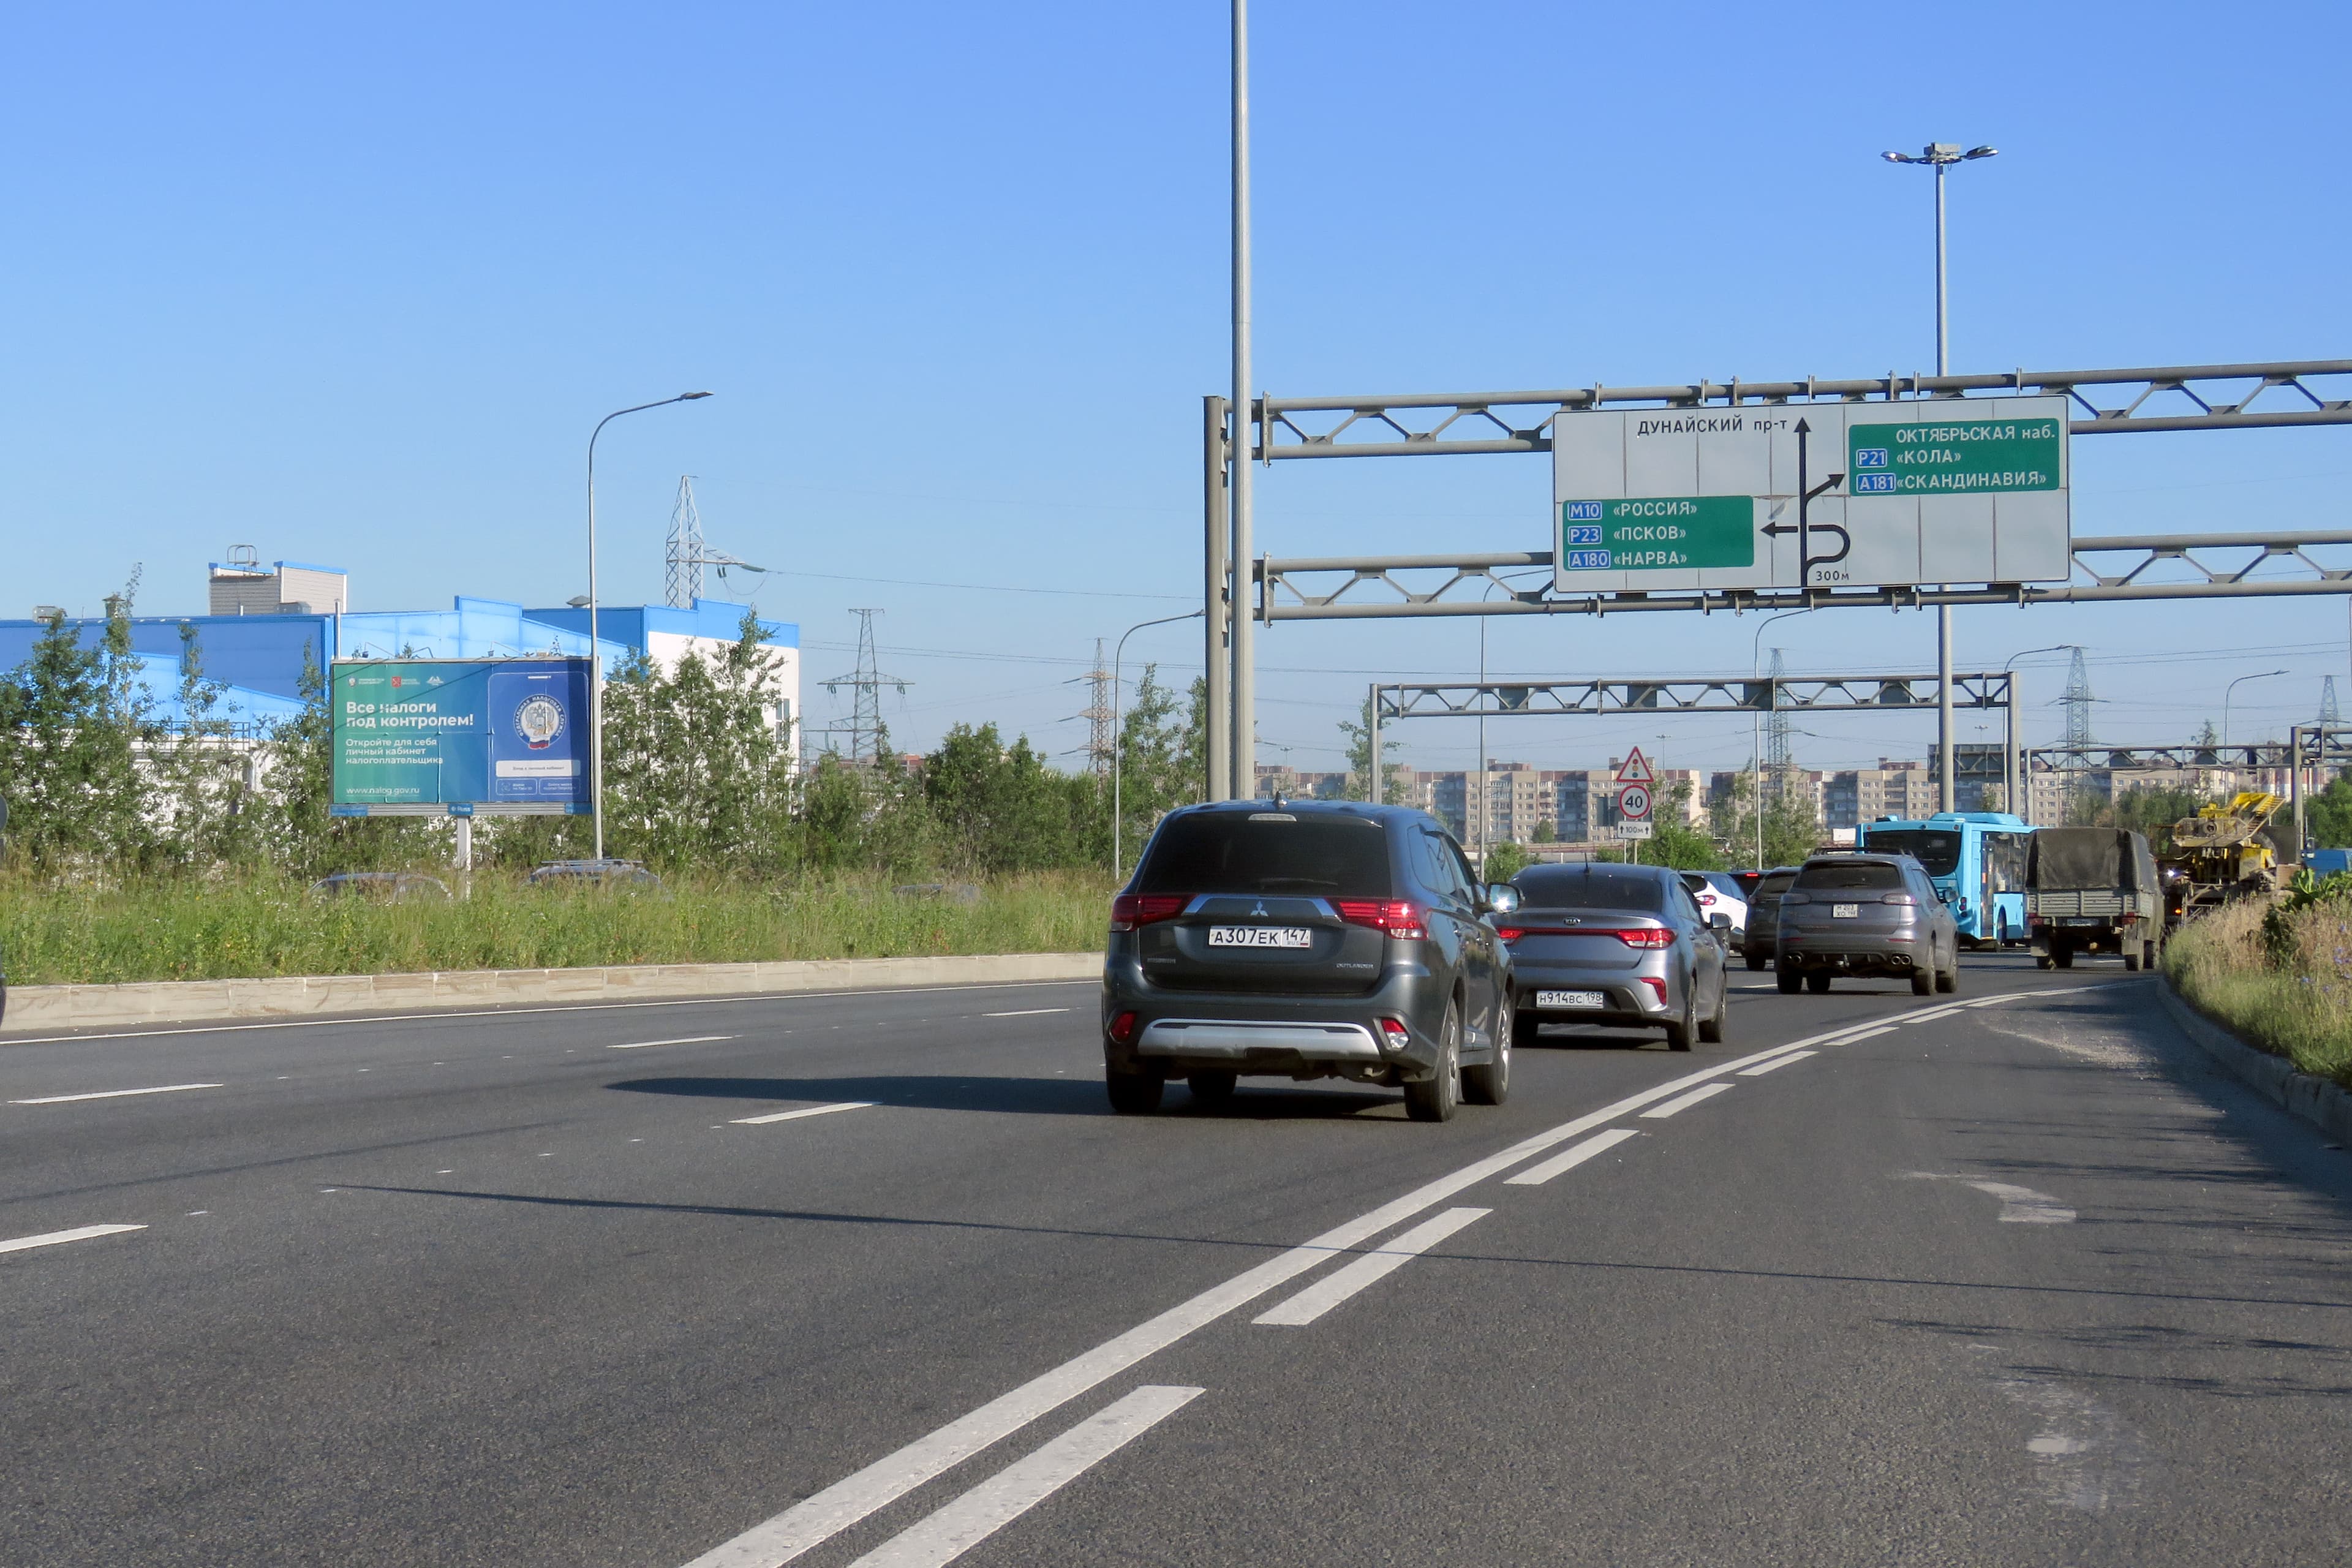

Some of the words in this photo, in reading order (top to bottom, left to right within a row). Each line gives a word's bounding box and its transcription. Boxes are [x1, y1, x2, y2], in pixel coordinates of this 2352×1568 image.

[1637, 413, 1743, 436] ДУНАЙСКИЙ
[1754, 420, 1788, 434] пр-т
[1896, 426, 2015, 443] ОКТЯБРЬСКАЯ
[2022, 424, 2056, 440] наб.
[1858, 450, 1886, 466] Р21
[1896, 449, 1961, 464] «КОЛА»
[1859, 476, 1894, 491] А181
[1897, 471, 2046, 489] «СКАНДИНАВИЯ»
[1570, 504, 1600, 518] М10
[1613, 501, 1697, 516] «РОССИЯ»
[1570, 528, 1599, 542] Р23
[1613, 526, 1686, 540] «ПСКОВ»
[1571, 552, 1608, 567] А180
[1613, 551, 1687, 565] «НАРВА»
[1815, 570, 1850, 581] 300м
[346, 701, 375, 714] Все
[379, 703, 437, 714] налоги
[346, 717, 377, 729] под
[380, 714, 474, 729] контролем!
[345, 738, 392, 747] Откройте
[414, 737, 438, 746] себя
[345, 747, 384, 756] личный
[385, 747, 426, 755] кабинет
[345, 756, 443, 766] налогоплательщика
[346, 786, 420, 796] www.nalog.gov.ru
[1625, 795, 1643, 808] 40
[1214, 927, 1279, 944] А307ЕК
[1283, 928, 1308, 941] 147
[1539, 992, 1582, 1004] Н914ВС
[1585, 992, 1602, 1001] 198
